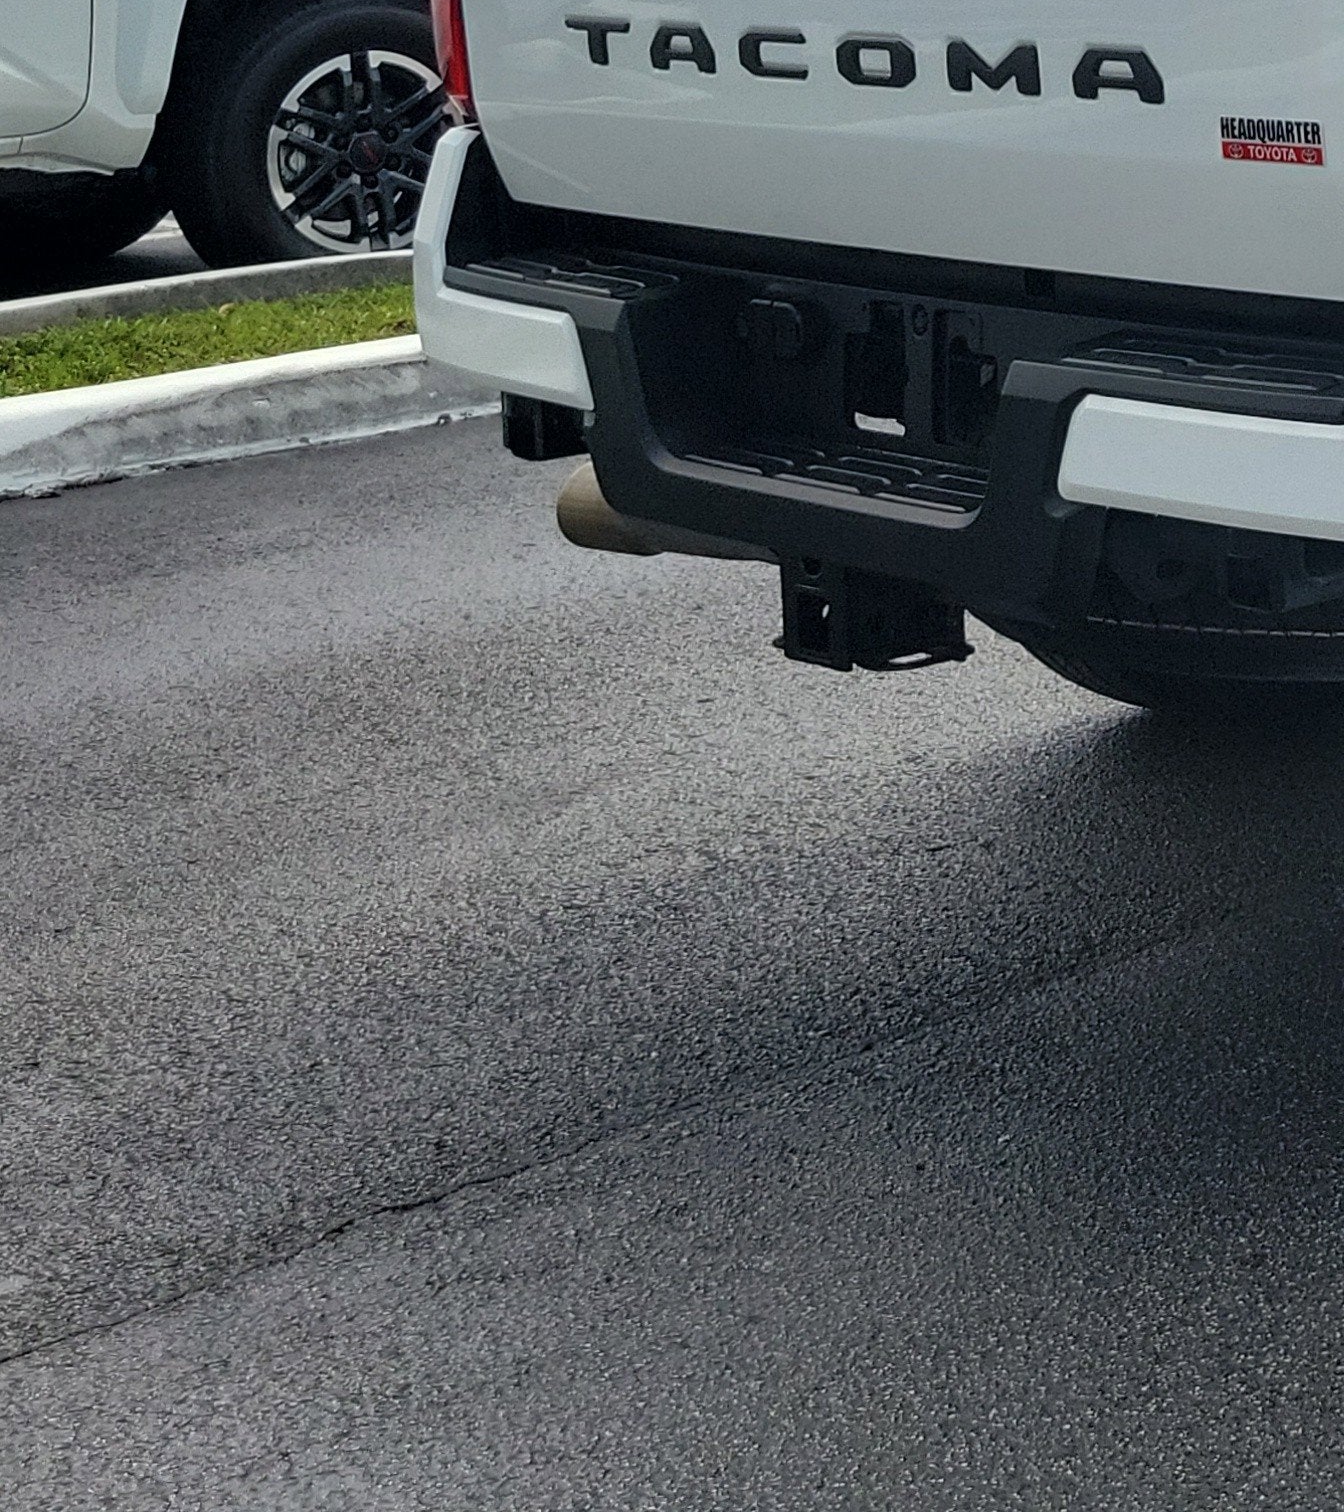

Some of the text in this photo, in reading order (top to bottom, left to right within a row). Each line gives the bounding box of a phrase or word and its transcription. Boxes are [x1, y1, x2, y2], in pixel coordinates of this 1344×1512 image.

[564, 15, 1165, 104] TACOMA
[1220, 116, 1321, 145] HEADQUARTER
[1247, 145, 1298, 162] TOYOTA
